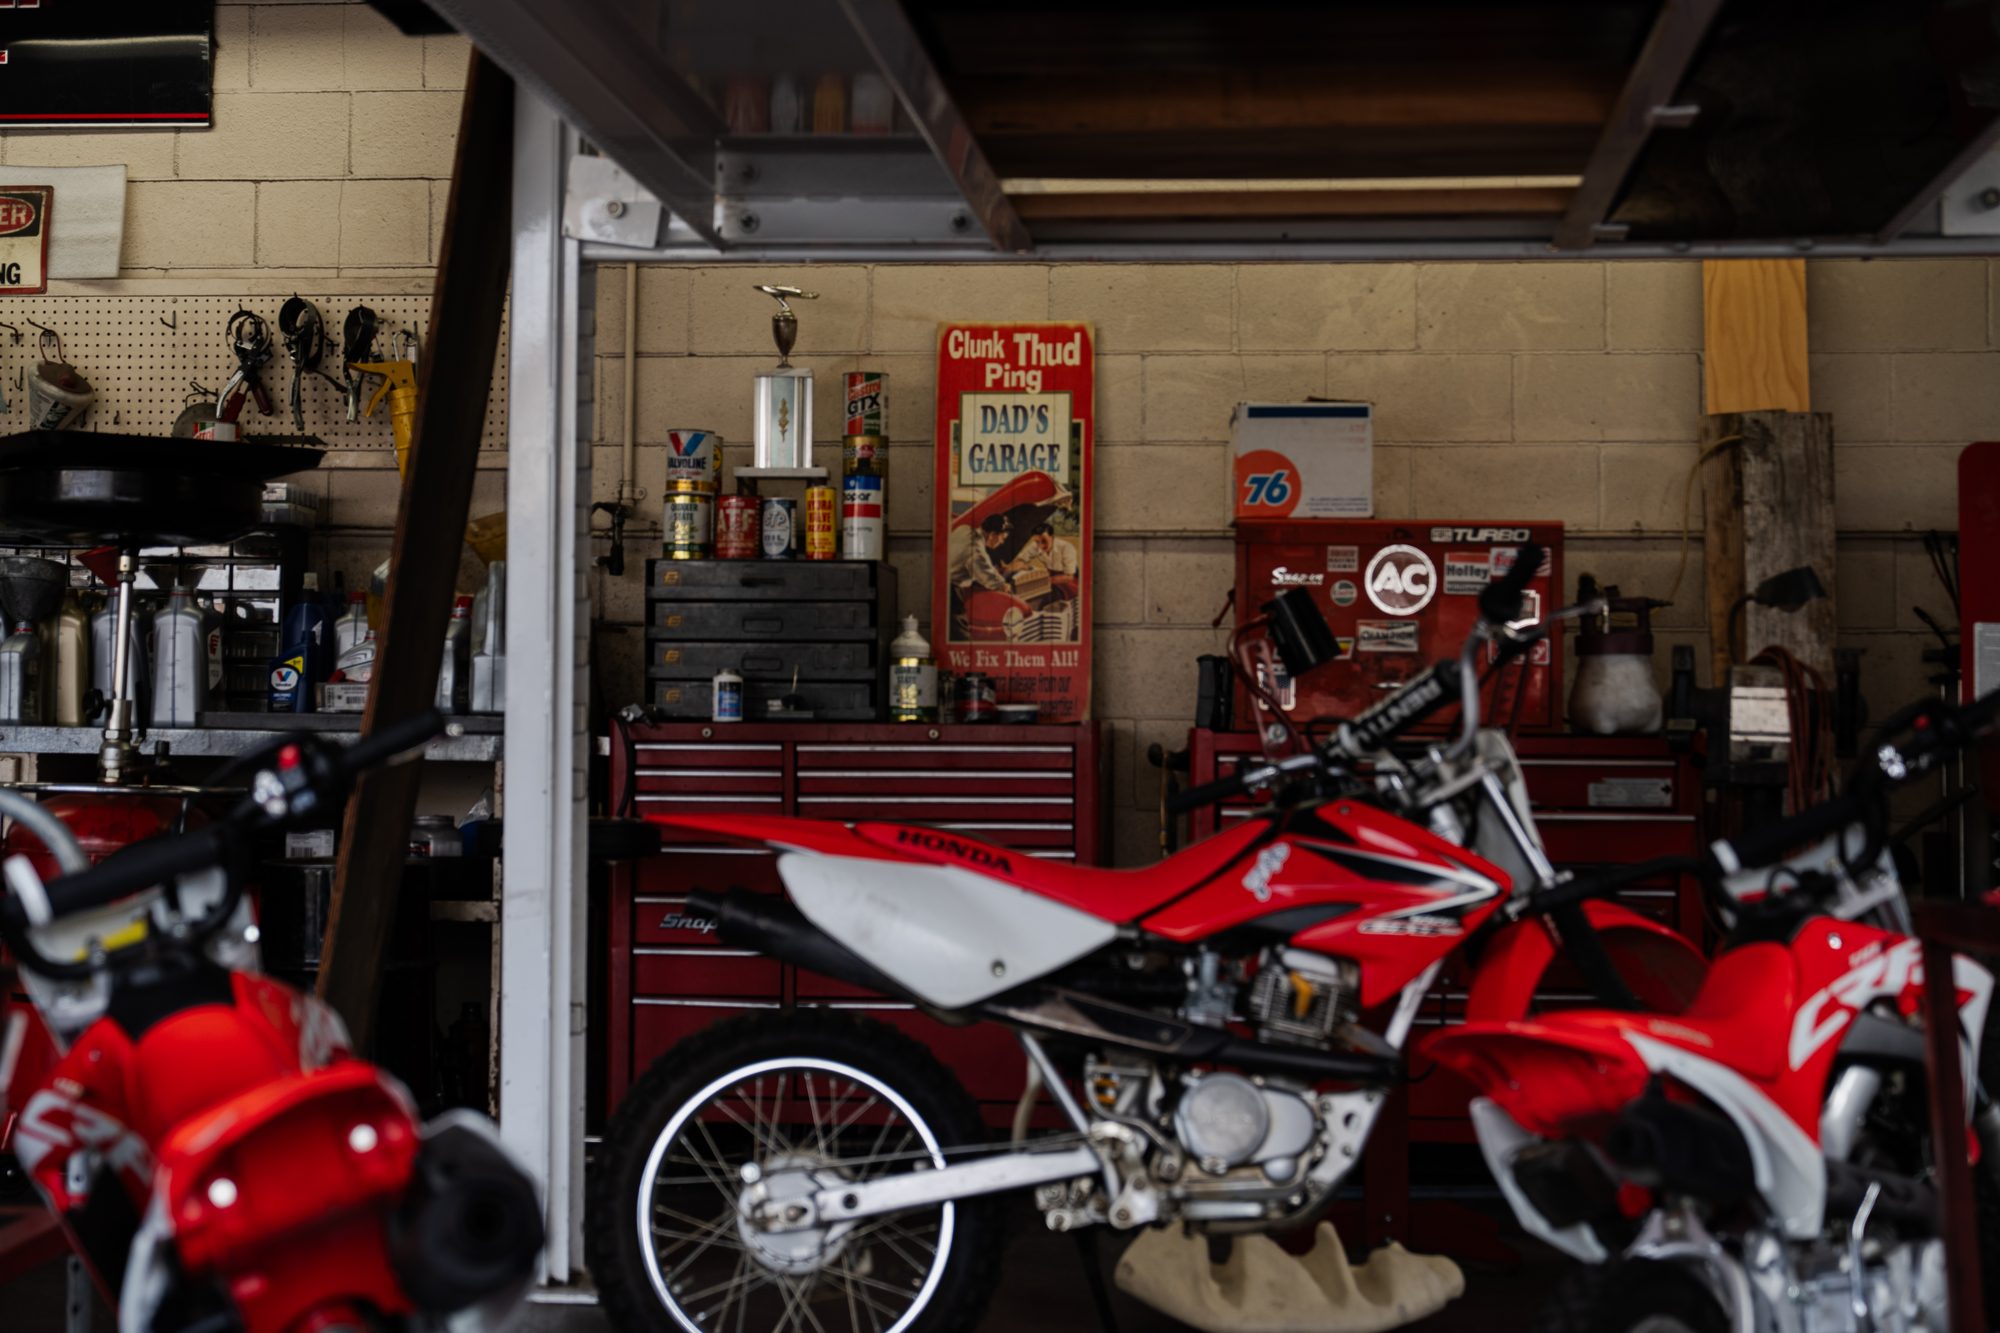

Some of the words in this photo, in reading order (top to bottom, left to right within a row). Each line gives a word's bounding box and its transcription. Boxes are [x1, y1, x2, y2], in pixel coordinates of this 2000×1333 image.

[948, 329, 1006, 360] Clunk
[1012, 331, 1081, 367] Thud
[984, 362, 1043, 395] Ping
[848, 392, 880, 416] GTX
[980, 404, 1049, 434] DAD'S
[968, 443, 1060, 474] GARAGE
[1245, 470, 1289, 506] 76
[717, 508, 755, 532] ATF
[1454, 527, 1531, 542] TURBO
[1372, 561, 1428, 596] AC
[1446, 565, 1489, 579] Holley
[948, 650, 970, 668] We
[975, 650, 999, 668] Fix
[1004, 650, 1046, 668] Them
[1051, 650, 1079, 668] All!
[898, 831, 1012, 875] HONDA
